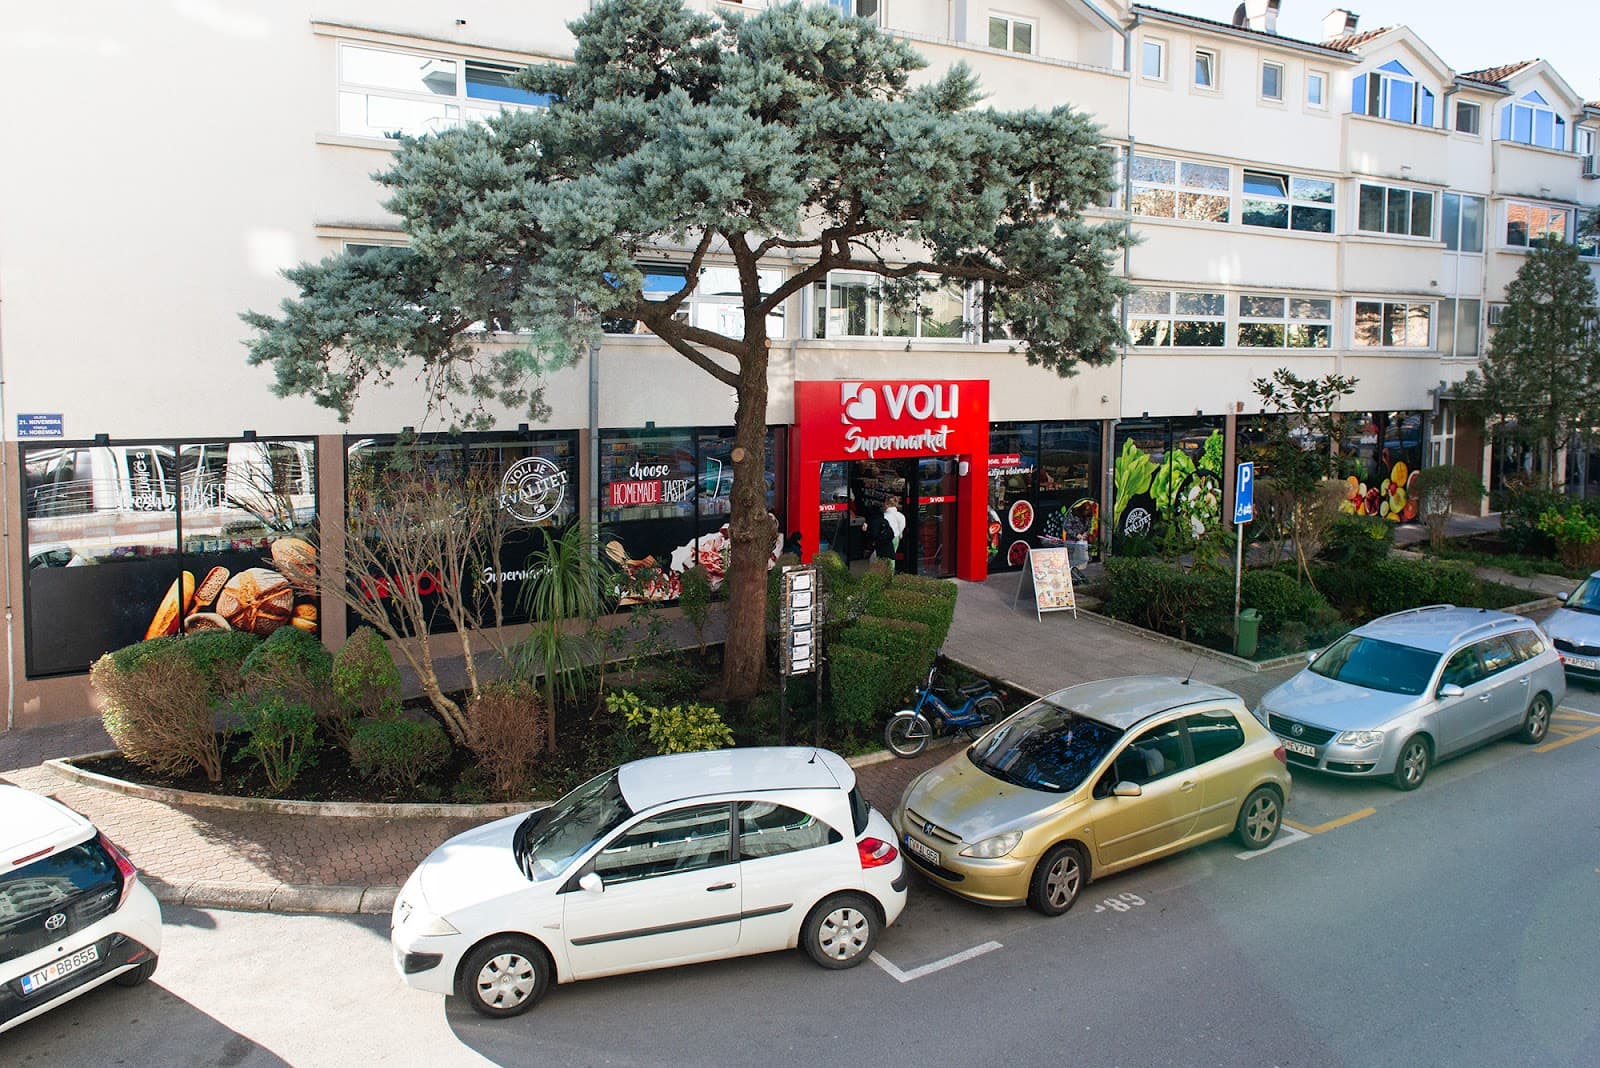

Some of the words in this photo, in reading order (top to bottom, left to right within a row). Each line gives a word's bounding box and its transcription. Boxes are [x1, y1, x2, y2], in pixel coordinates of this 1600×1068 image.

[882, 384, 959, 420] VOLI
[844, 424, 955, 459] Supermarket
[508, 463, 532, 485] VOLI
[534, 463, 548, 475] JE
[629, 461, 671, 480] choose
[1241, 466, 1250, 492] P
[499, 470, 568, 509] KVALITET
[613, 481, 658, 505] HOMEMADE
[662, 479, 689, 503] TASTY
[33, 969, 49, 986] TV
[55, 947, 96, 975] BB655
